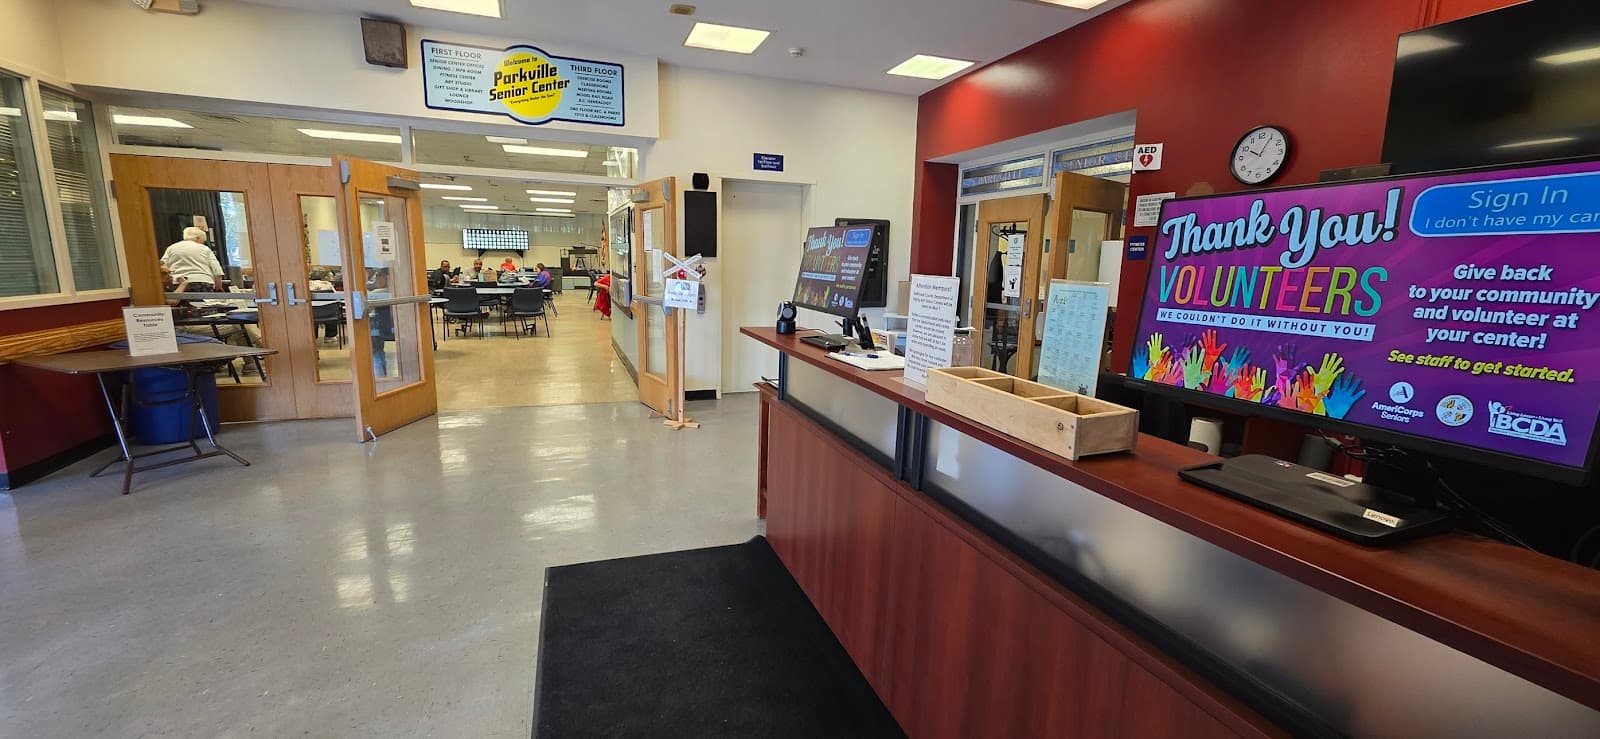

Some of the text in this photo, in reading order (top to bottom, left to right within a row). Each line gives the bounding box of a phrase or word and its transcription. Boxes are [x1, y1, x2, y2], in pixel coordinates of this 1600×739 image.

[431, 48, 482, 59] FIRST FLOOR
[504, 58, 530, 66] Welcome
[494, 64, 557, 86] Parkville
[570, 64, 618, 76] THIRD FLOOR
[489, 80, 570, 101] Senior Center
[1138, 146, 1157, 154] AED
[1468, 185, 1569, 212] Sign In
[1162, 199, 1275, 260] Thank
[1279, 188, 1401, 268] You!
[1425, 218, 1430, 229] I
[1434, 216, 1479, 229] don't
[1483, 214, 1526, 227] have
[1532, 214, 1564, 227] my
[807, 231, 827, 253] Thank
[825, 230, 846, 256] You!
[1453, 263, 1553, 281] Give back
[1159, 265, 1388, 316] VOLUNTEERS
[1408, 284, 1600, 310] to your community
[1160, 311, 1370, 336] WE COULDN'T DO IT WITHOUT YOU!
[1413, 306, 1579, 328] and volunteer at
[1426, 328, 1548, 350] your center!
[1387, 350, 1576, 383] See staff to get started.
[1371, 402, 1424, 418] AmeriCorps
[1381, 411, 1410, 424] Seniors
[1496, 414, 1566, 444] BCDA
